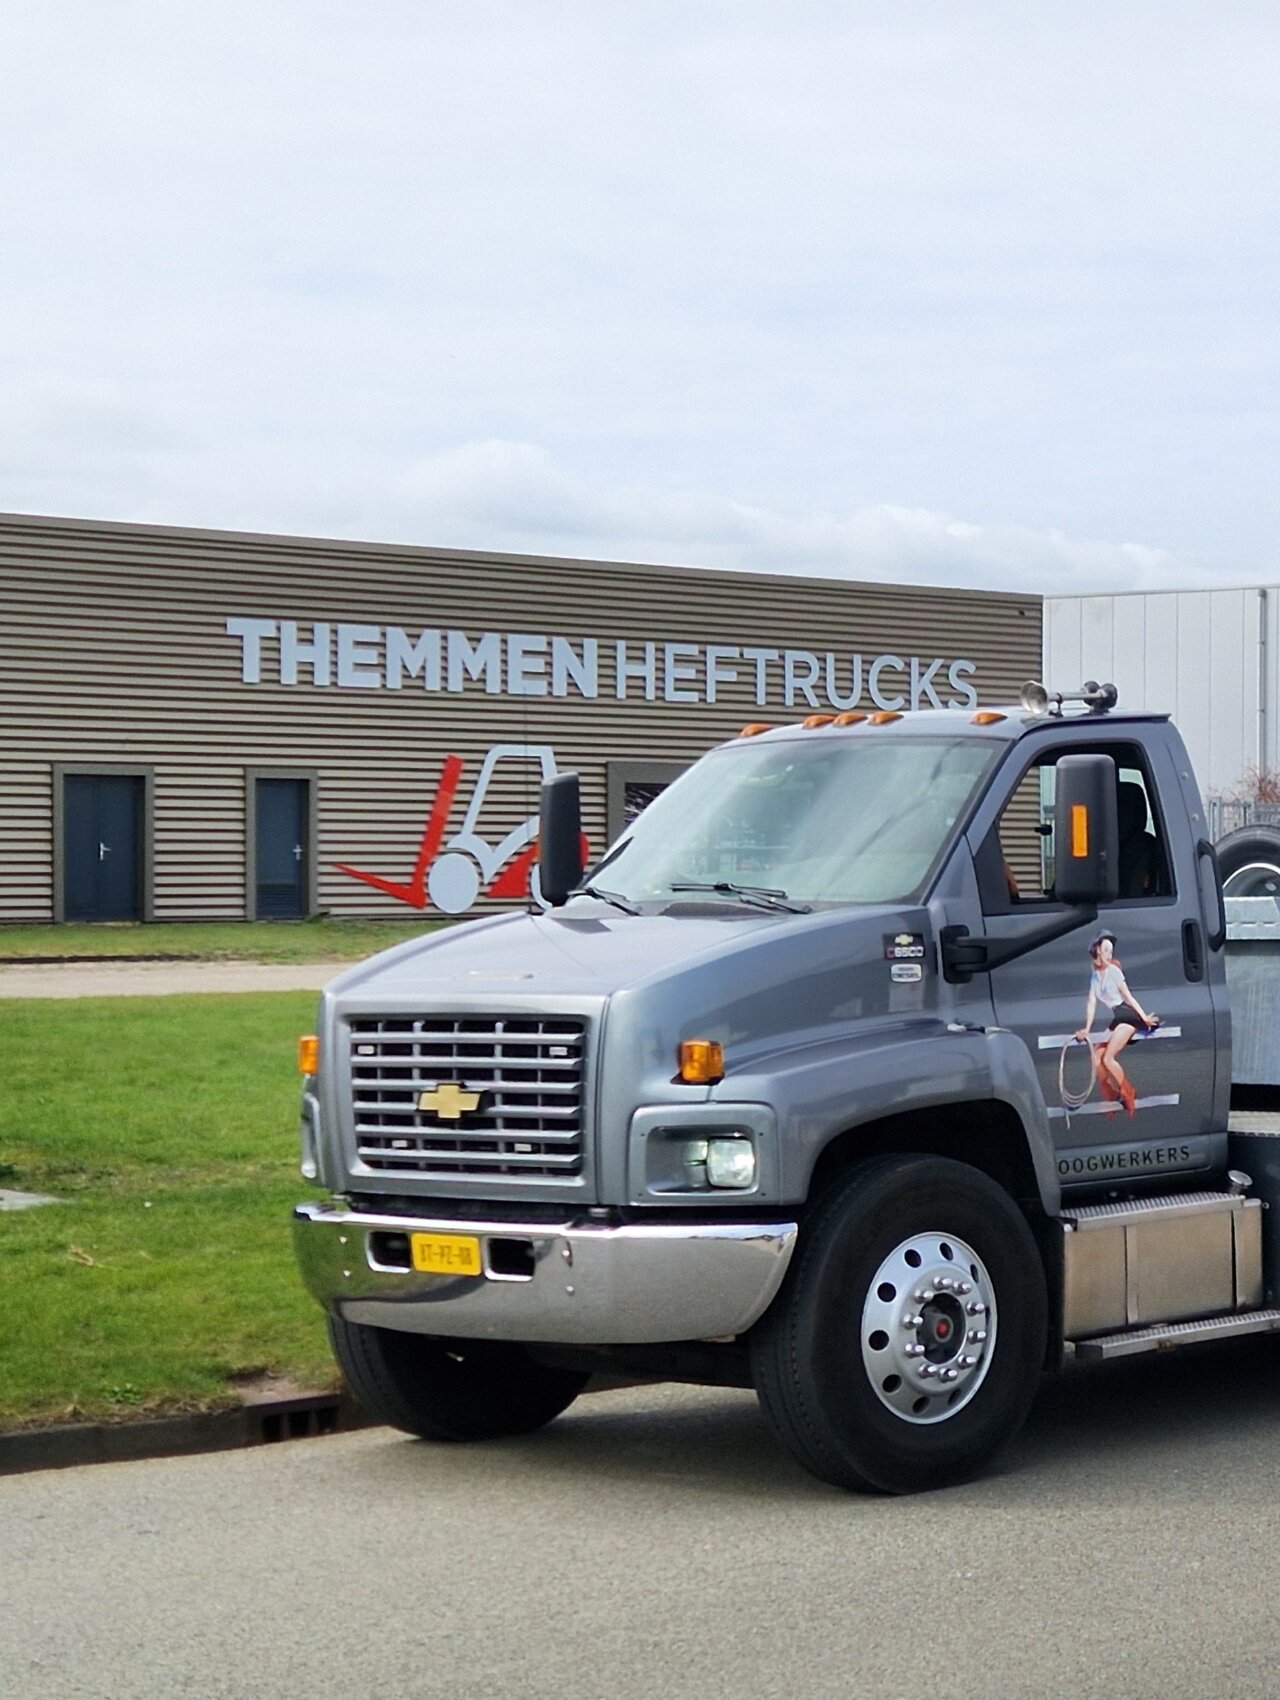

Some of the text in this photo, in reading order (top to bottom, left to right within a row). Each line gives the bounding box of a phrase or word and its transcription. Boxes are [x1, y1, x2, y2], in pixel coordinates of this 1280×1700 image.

[226, 617, 978, 711] THEMMEN HEFTRUCKS
[1058, 1145, 1190, 1175] OOGWERKERS
